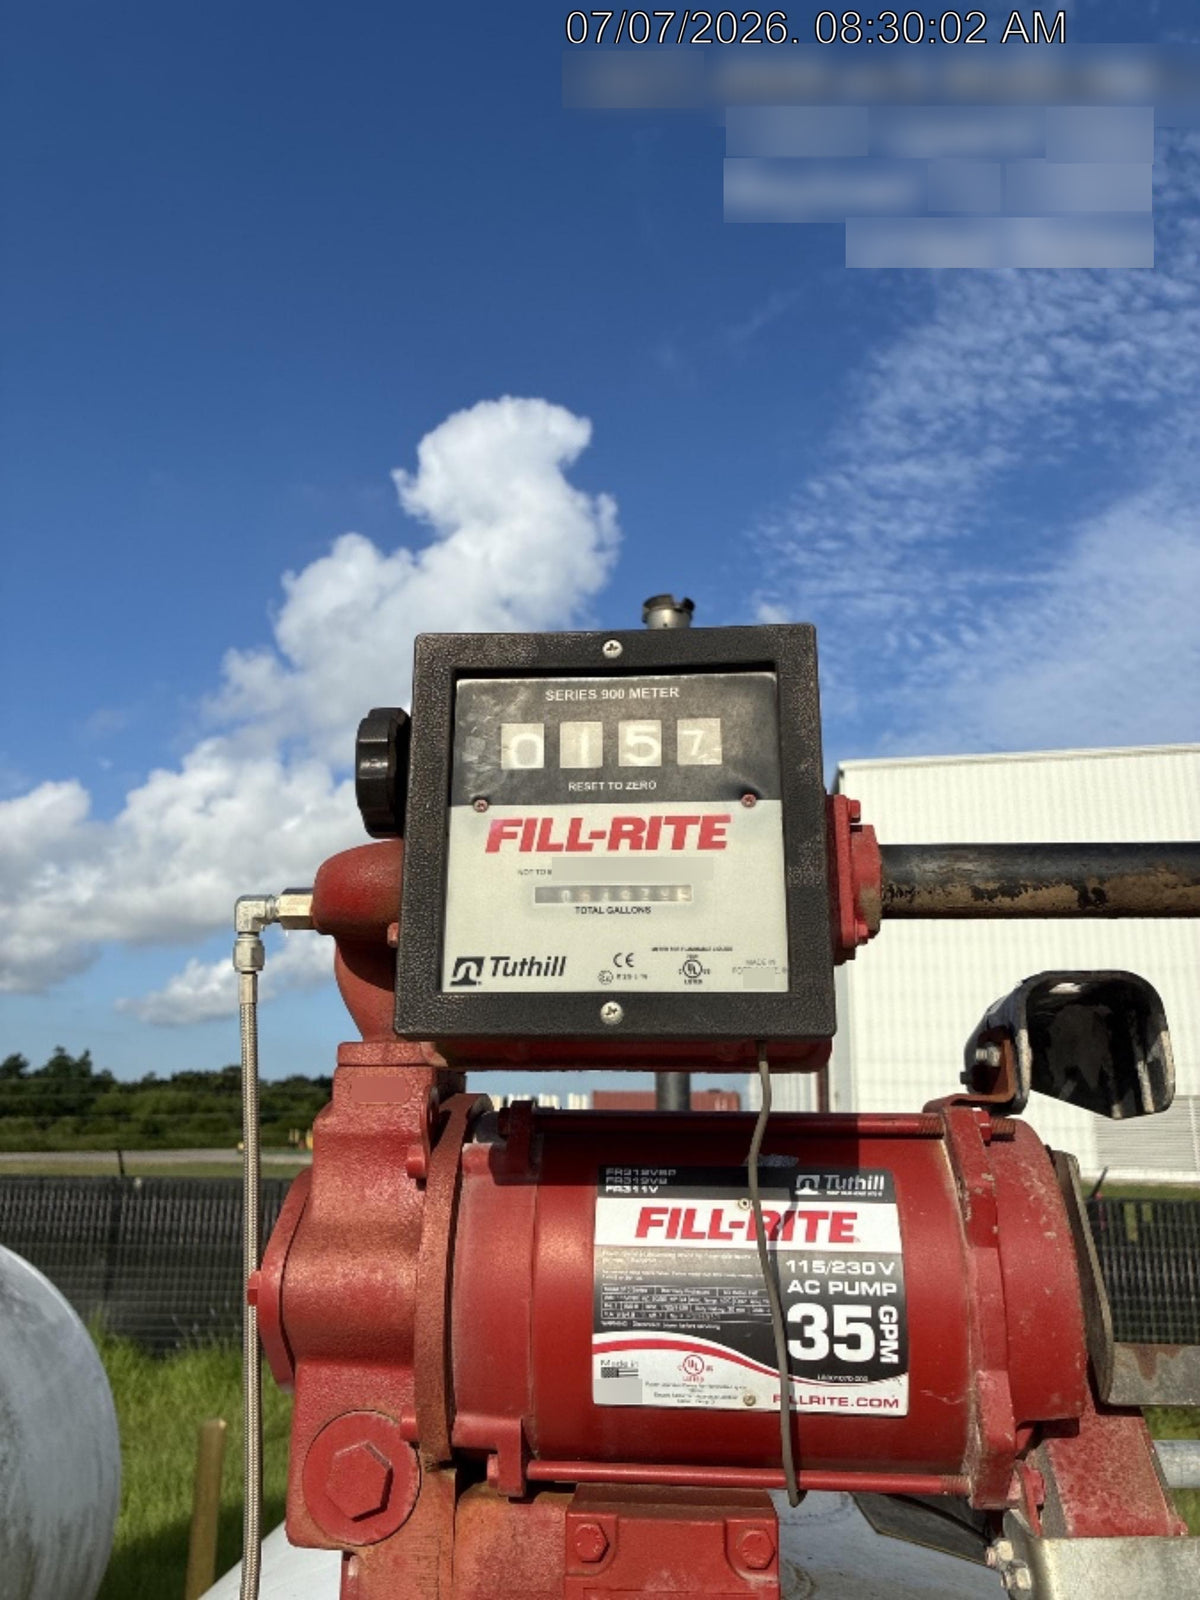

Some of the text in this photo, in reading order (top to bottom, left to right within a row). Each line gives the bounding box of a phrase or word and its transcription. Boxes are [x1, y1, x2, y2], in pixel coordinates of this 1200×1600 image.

[545, 687, 680, 702] SERIES 900 METER
[568, 780, 657, 792] RESET TO ZERO
[485, 814, 732, 854] FILL-RITE
[575, 906, 651, 915] TOTAL GALLONS
[490, 955, 567, 977] Tuthill
[823, 1174, 885, 1190] Tuthill
[634, 1206, 859, 1243] FILL-RITE
[787, 1280, 897, 1297] AC PUMP
[787, 1303, 900, 1365] 35 GPM
[772, 1394, 899, 1408] FLLRITE.COM
